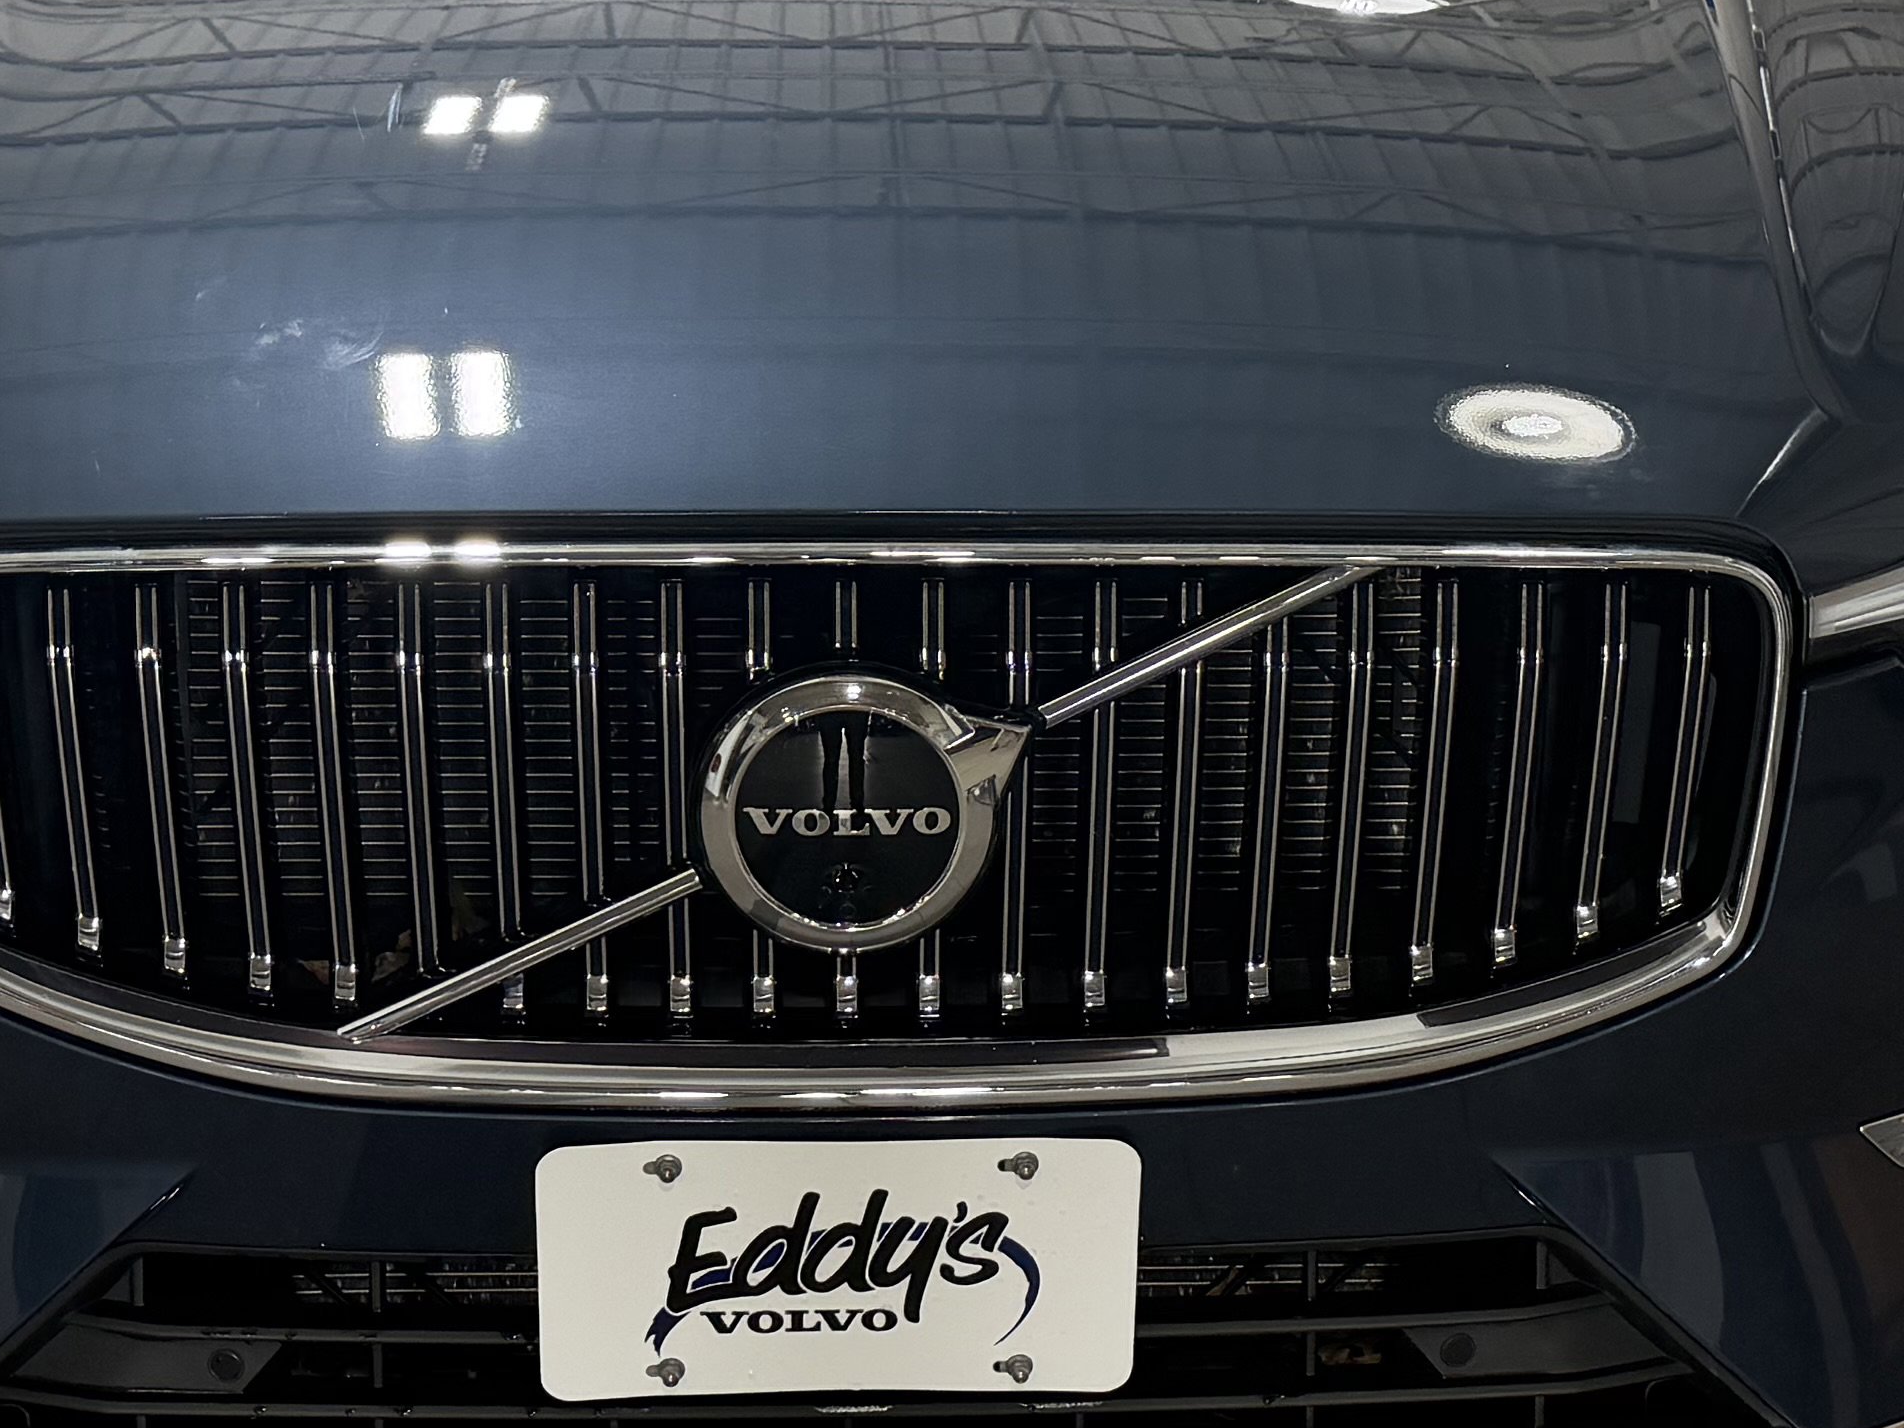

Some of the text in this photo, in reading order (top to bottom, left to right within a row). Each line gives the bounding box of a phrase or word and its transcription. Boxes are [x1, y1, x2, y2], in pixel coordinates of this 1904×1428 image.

[743, 807, 951, 836] VOLVO
[666, 1189, 1010, 1323] Eddy's
[700, 1308, 897, 1333] VOLVO
